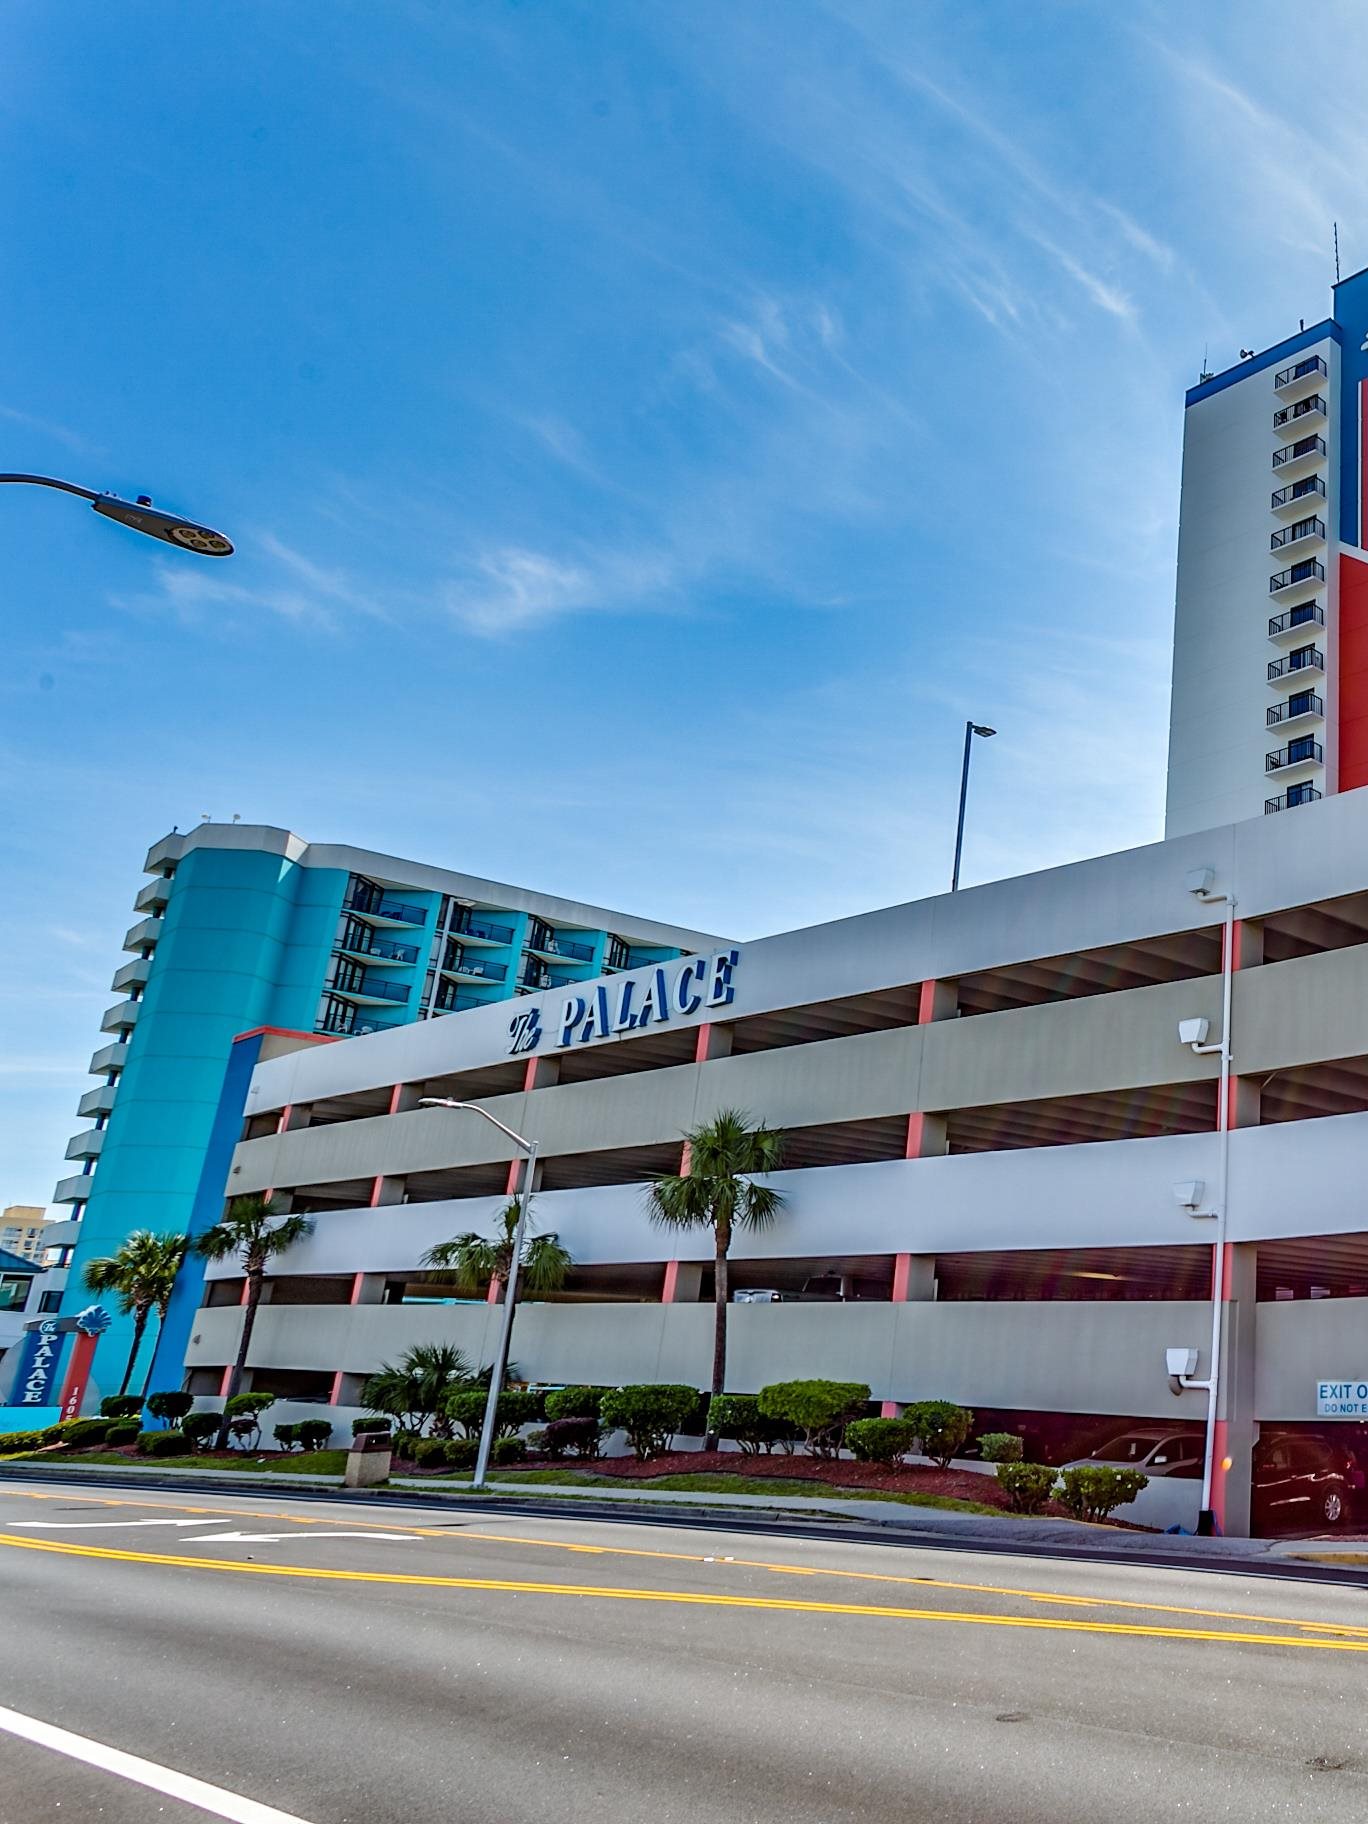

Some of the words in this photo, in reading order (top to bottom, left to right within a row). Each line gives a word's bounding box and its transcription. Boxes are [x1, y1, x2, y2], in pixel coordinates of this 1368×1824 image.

[507, 1007, 543, 1055] The
[554, 950, 739, 1048] PALACE
[22, 1334, 58, 1403] PALACE
[1319, 1384, 1352, 1399] EXIT
[1324, 1403, 1338, 1413] DO
[1340, 1403, 1359, 1413] NOT
